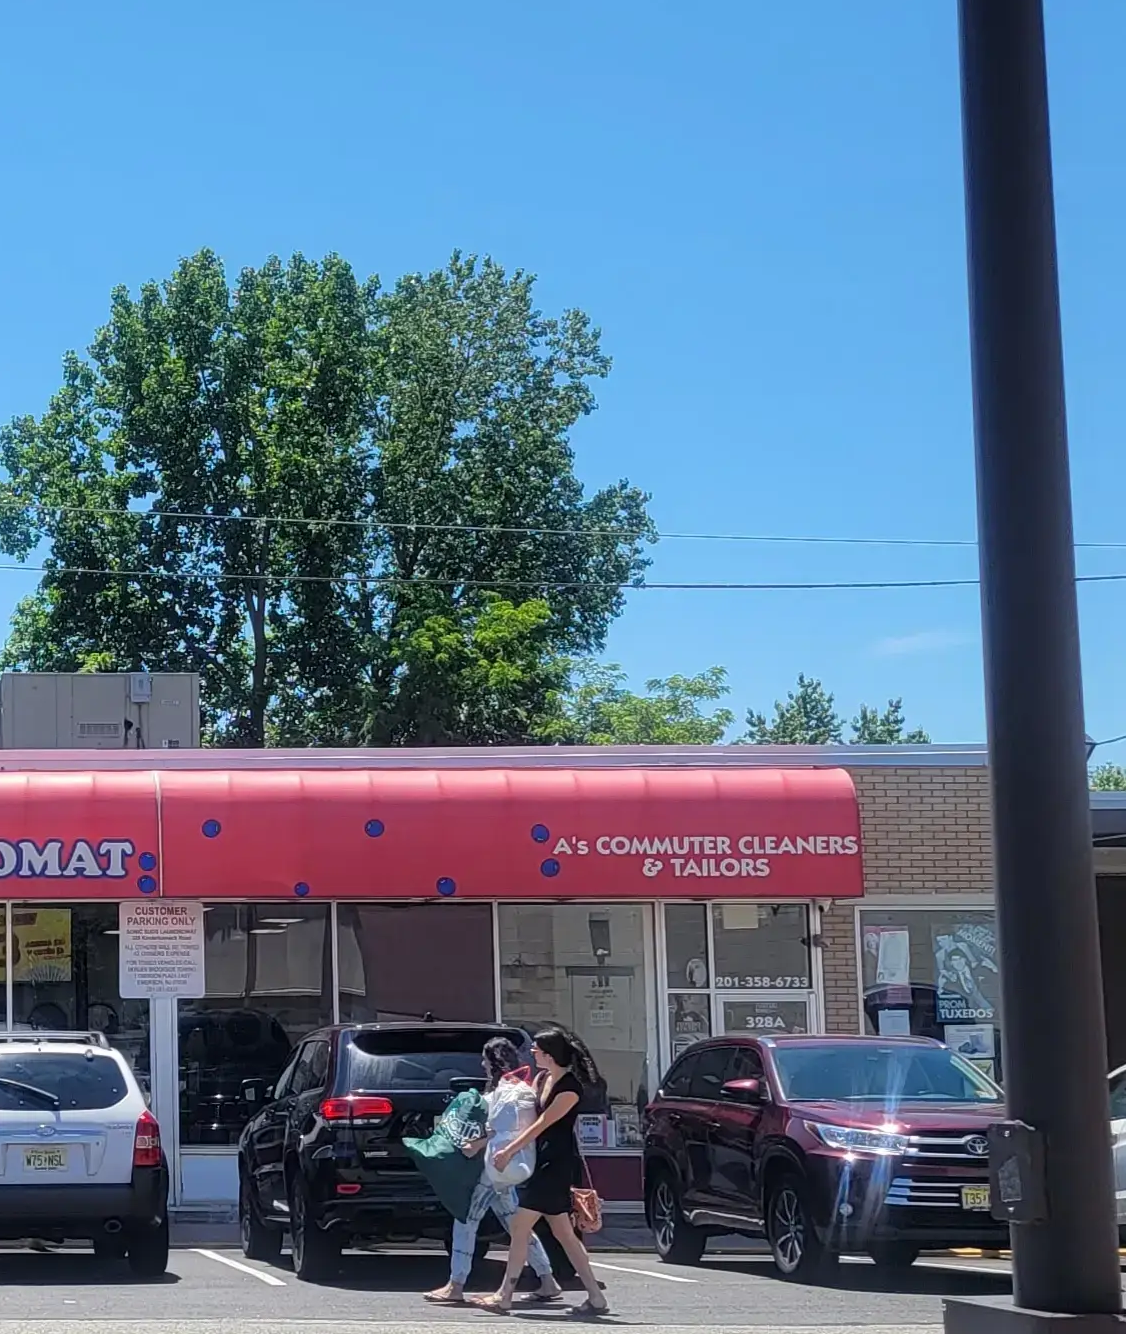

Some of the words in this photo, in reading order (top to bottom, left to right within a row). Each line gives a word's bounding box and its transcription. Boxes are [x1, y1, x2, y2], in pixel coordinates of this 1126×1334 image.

[553, 837, 589, 855] A's
[596, 836, 731, 855] COMMUTER
[738, 835, 859, 855] CLEANERS
[642, 858, 663, 878] &
[670, 858, 770, 877] TAILORS
[134, 906, 188, 916] CUSTOMER
[126, 917, 169, 926] PARKING
[171, 917, 196, 926] ONLY
[715, 976, 808, 988] 201-358-6733
[939, 1000, 967, 1009] PROM
[939, 1008, 994, 1019] TUXEDOS
[745, 1016, 786, 1028] 328A
